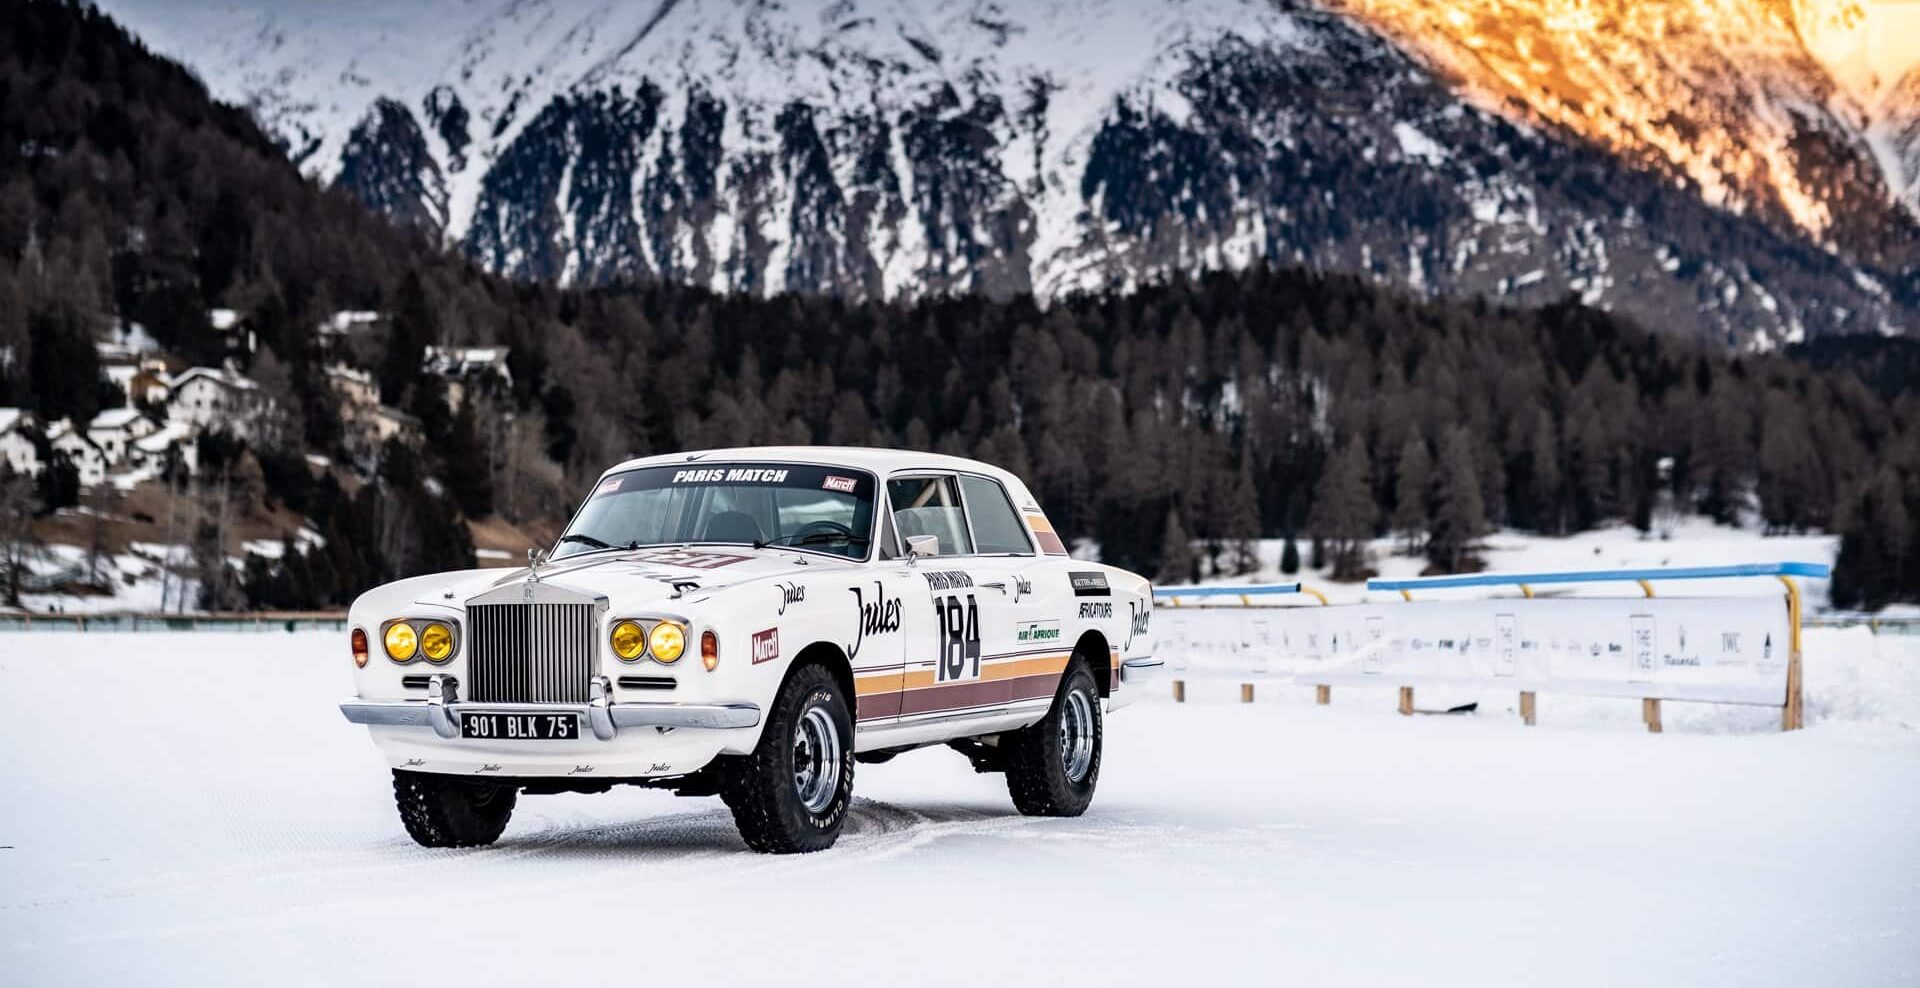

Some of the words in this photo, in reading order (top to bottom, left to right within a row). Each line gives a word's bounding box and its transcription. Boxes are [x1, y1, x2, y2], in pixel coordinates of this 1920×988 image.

[672, 469, 725, 483] PARIS
[725, 469, 788, 482] MATCH
[921, 571, 949, 590] PARIS
[943, 571, 974, 589] MATCH
[1011, 574, 1032, 604] Jules
[774, 581, 806, 616] Jules
[1078, 602, 1112, 618] AFRICATOURS
[847, 580, 902, 661] Jules
[1124, 598, 1150, 652] Jules
[934, 594, 981, 682] 184
[1018, 630, 1028, 640] AIR
[470, 715, 497, 737] 901
[507, 716, 537, 737] BLK
[547, 716, 567, 737] 75
[568, 765, 594, 775] Jules
[644, 763, 671, 774] Jules
